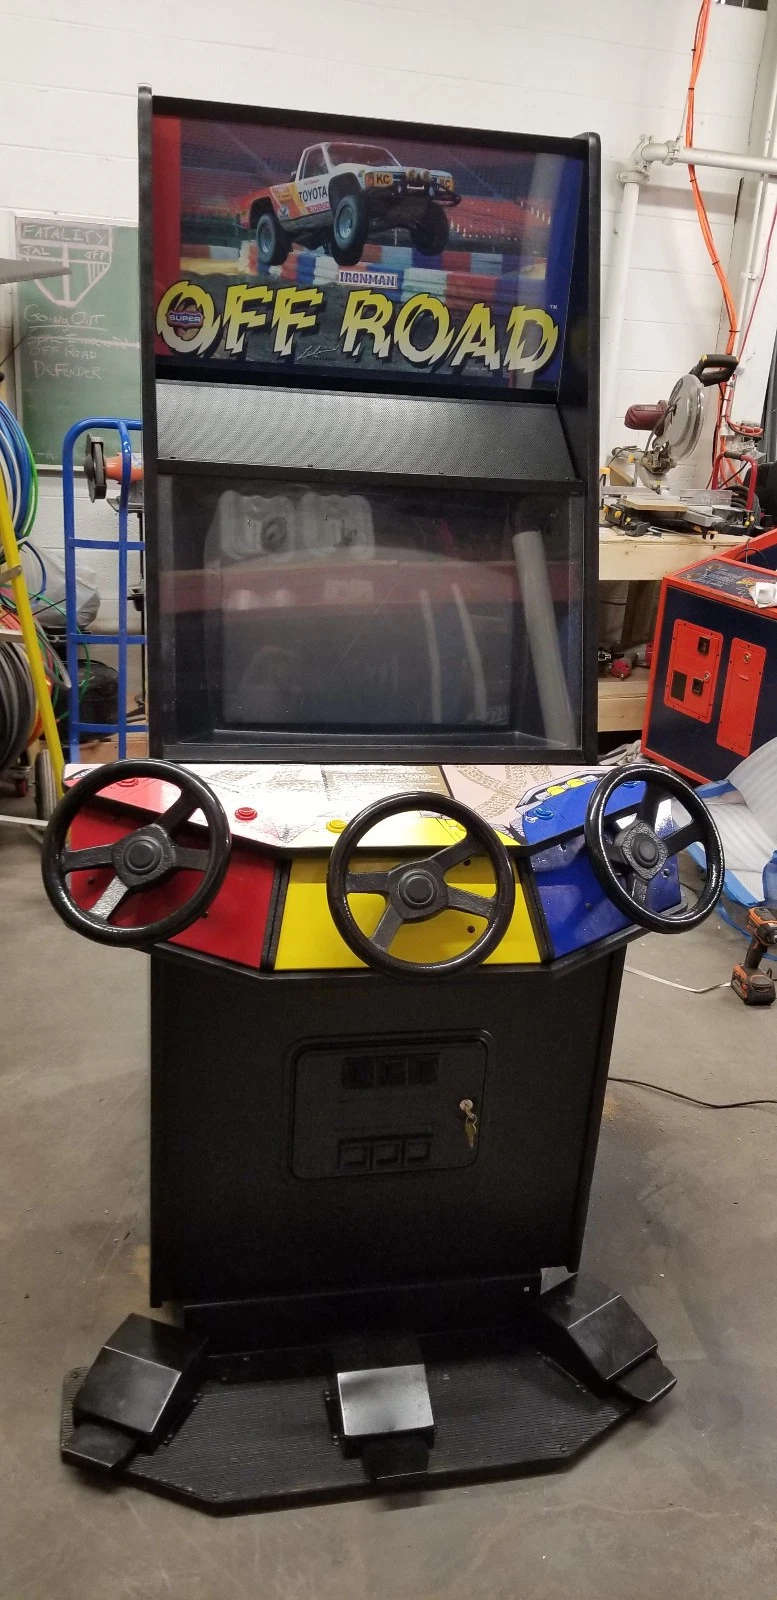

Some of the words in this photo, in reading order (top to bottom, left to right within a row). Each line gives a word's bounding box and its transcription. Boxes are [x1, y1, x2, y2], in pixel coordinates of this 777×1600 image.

[376, 174, 390, 185] KC
[298, 185, 328, 203] TOYOTA
[23, 224, 107, 245] FATALITY
[340, 271, 396, 287] IRONMAN
[155, 280, 324, 358] OFF
[339, 289, 559, 374] ROAD
[170, 314, 201, 323] SUPER
